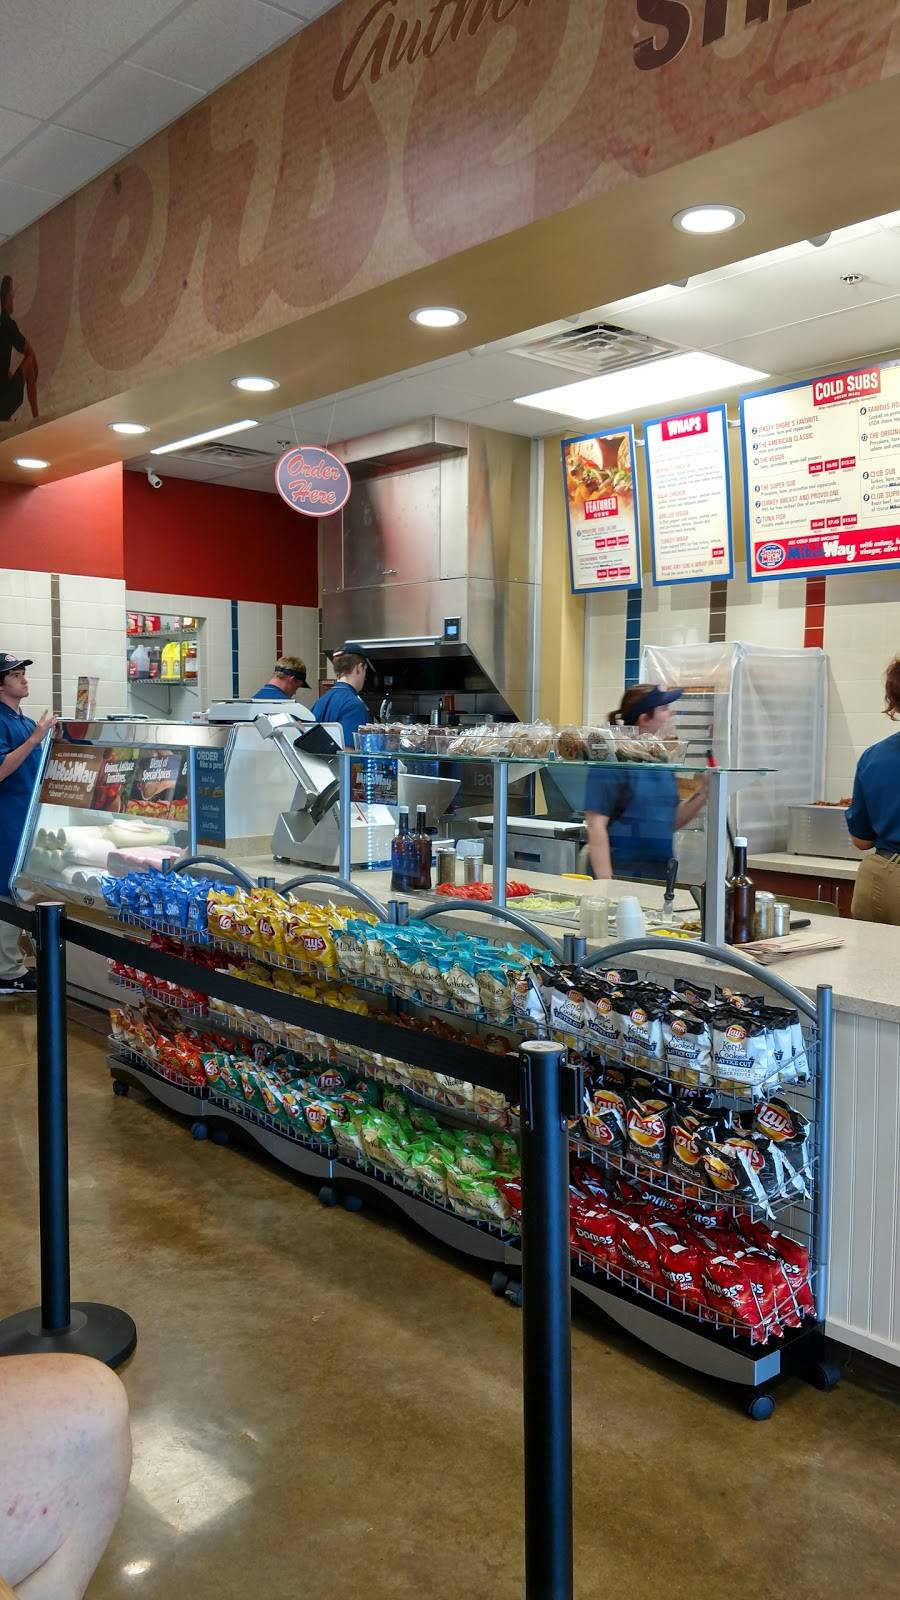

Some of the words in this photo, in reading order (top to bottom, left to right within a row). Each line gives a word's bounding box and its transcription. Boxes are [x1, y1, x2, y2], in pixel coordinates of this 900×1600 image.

[815, 379, 844, 401] COLD
[847, 372, 879, 392] SUBS
[667, 416, 702, 437] WRAPS
[796, 415, 818, 426] FAVORITE
[768, 436, 793, 447] AMERICAN
[793, 432, 814, 442] CLASSIC
[287, 454, 341, 481] Order
[288, 480, 337, 505] Here
[585, 496, 617, 514] FEATURED
[822, 540, 857, 561] Way
[196, 751, 219, 761] ORDER
[668, 1041, 696, 1051] Cooked
[719, 1050, 748, 1060] Cooked
[672, 1156, 701, 1178] Barbecue
